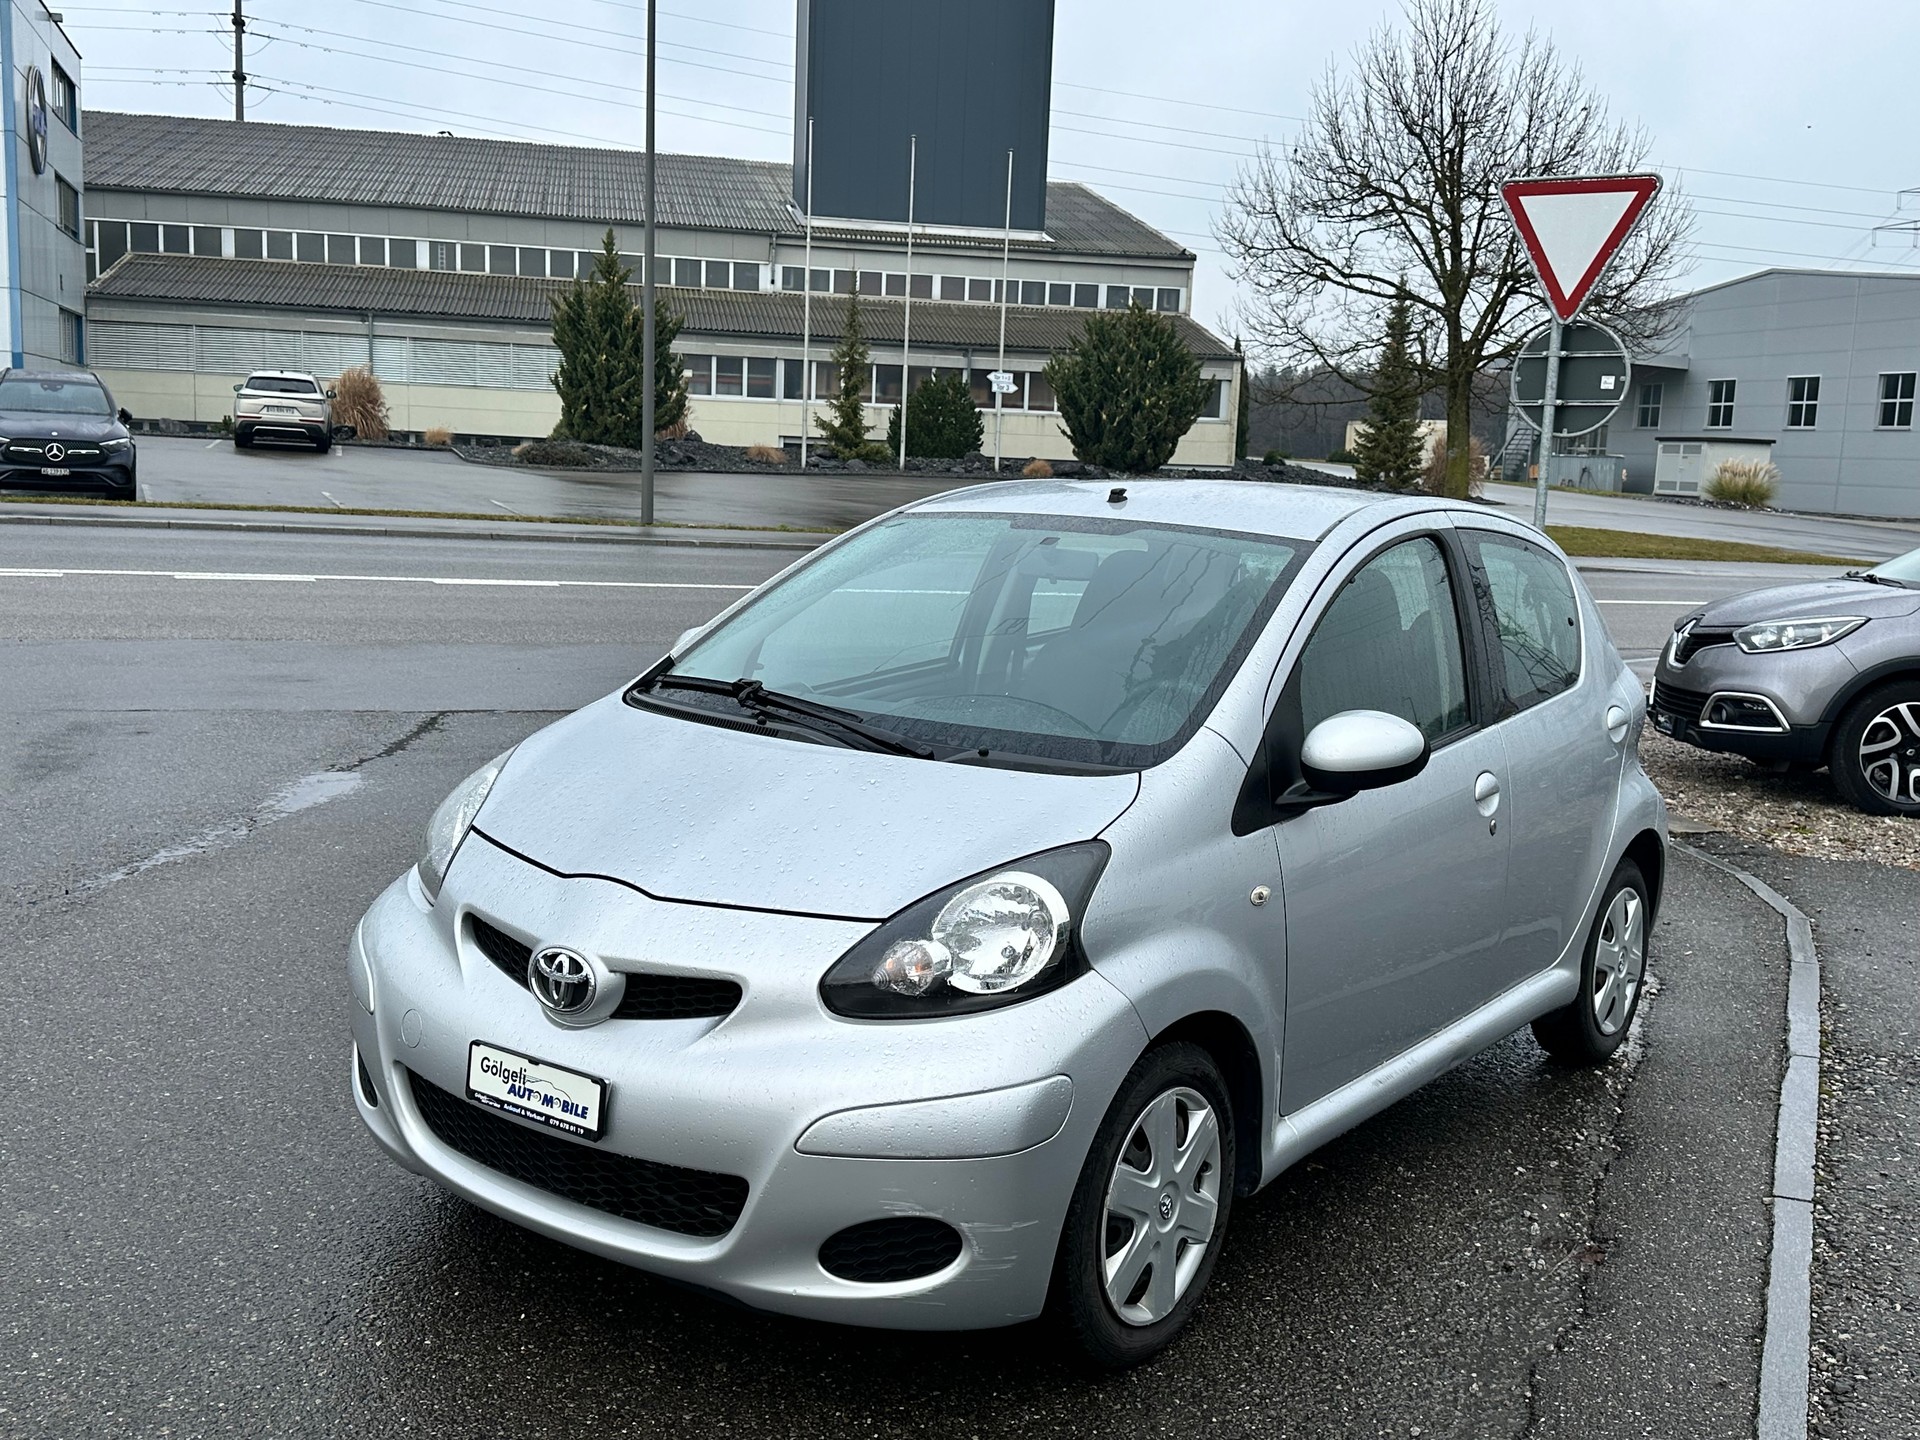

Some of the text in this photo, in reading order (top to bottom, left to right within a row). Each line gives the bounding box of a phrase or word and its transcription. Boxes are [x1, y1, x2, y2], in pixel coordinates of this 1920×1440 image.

[996, 383, 1005, 391] Tor
[480, 1056, 527, 1086] Gölgeli
[549, 1118, 560, 1127] 079
